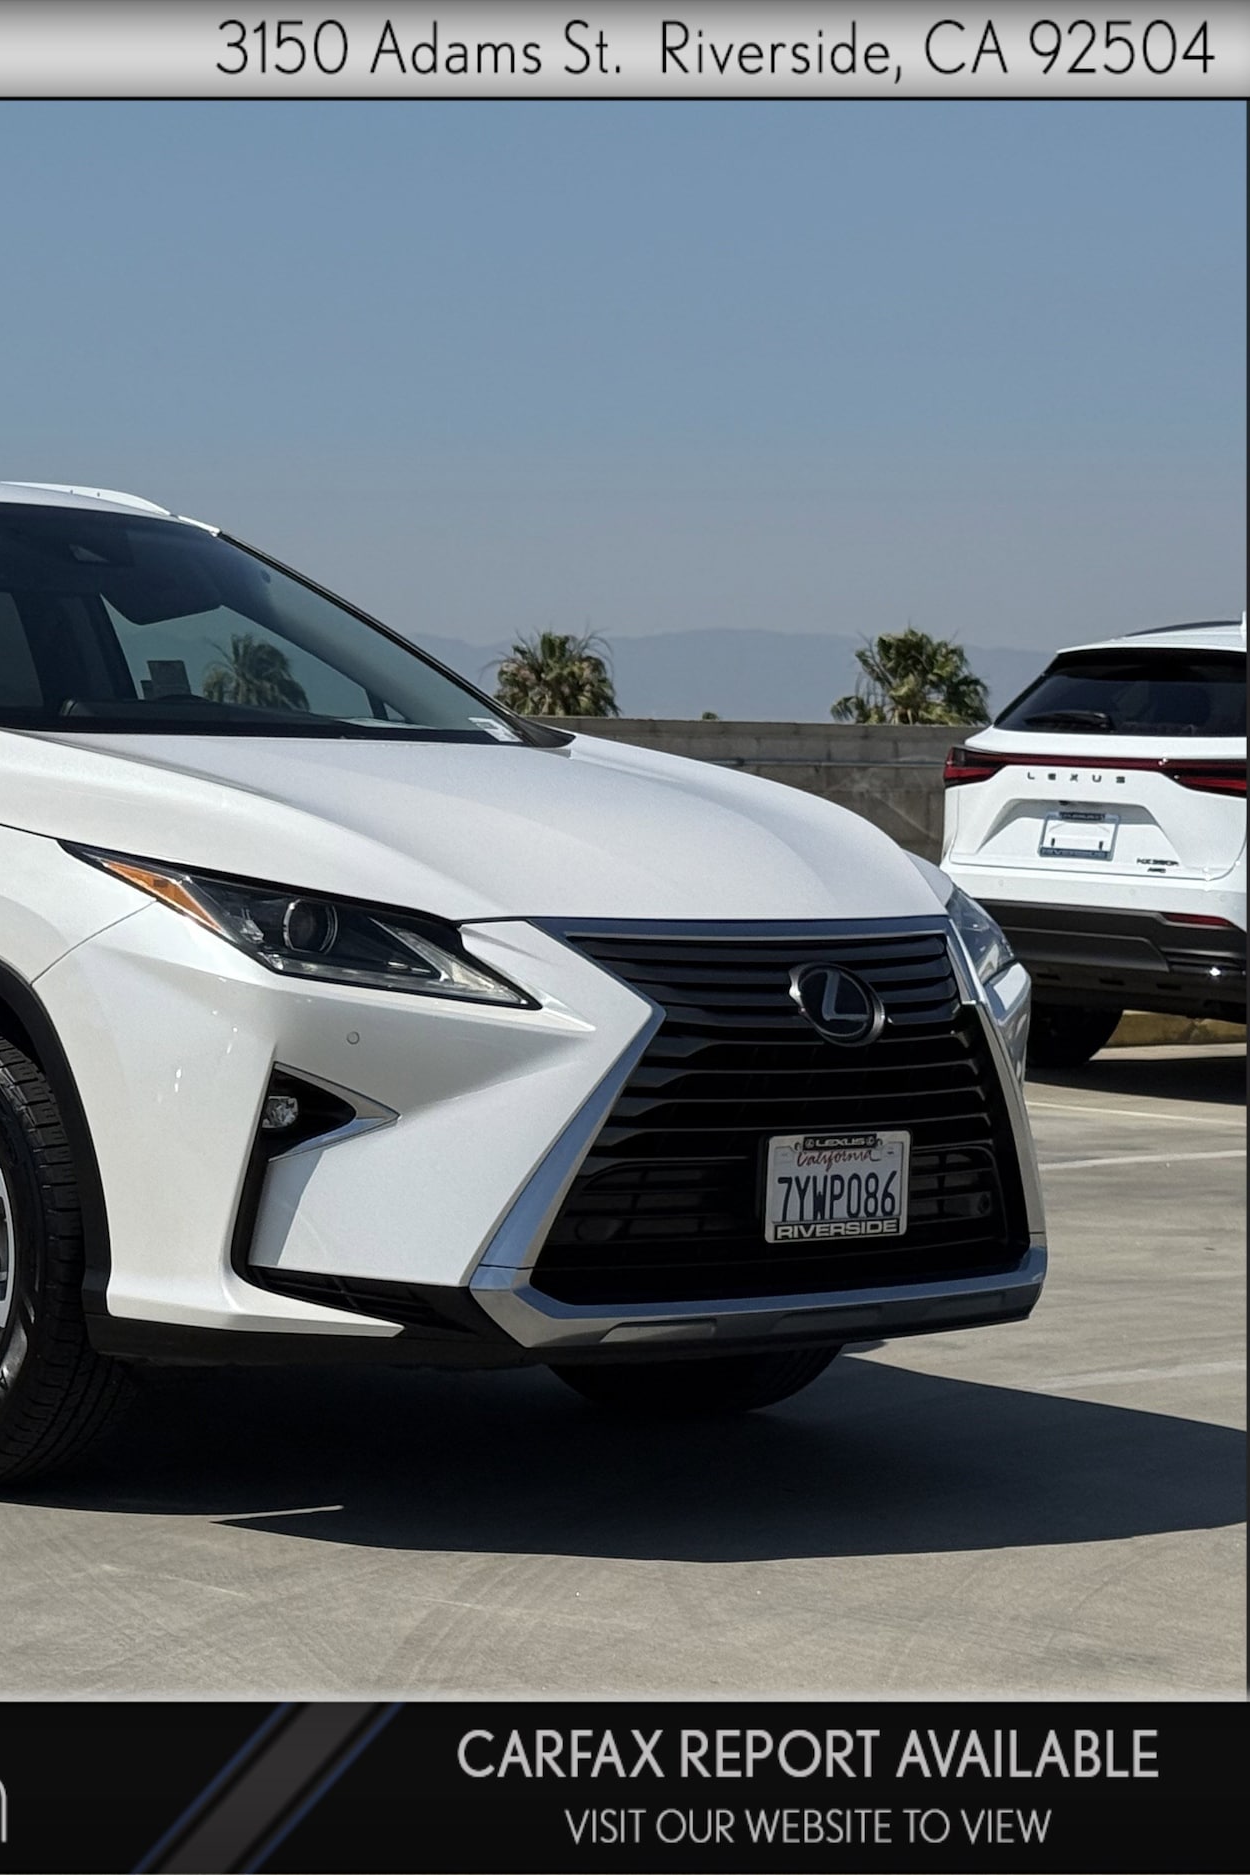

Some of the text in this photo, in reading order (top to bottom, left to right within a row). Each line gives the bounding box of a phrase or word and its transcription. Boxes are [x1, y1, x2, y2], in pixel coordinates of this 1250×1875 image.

[1027, 772, 1126, 784] LEXUS
[815, 1137, 866, 1147] LEXUS
[796, 1149, 881, 1172] California
[777, 1170, 898, 1222] 7YWP086
[776, 1219, 898, 1239] RIVERSIDE
